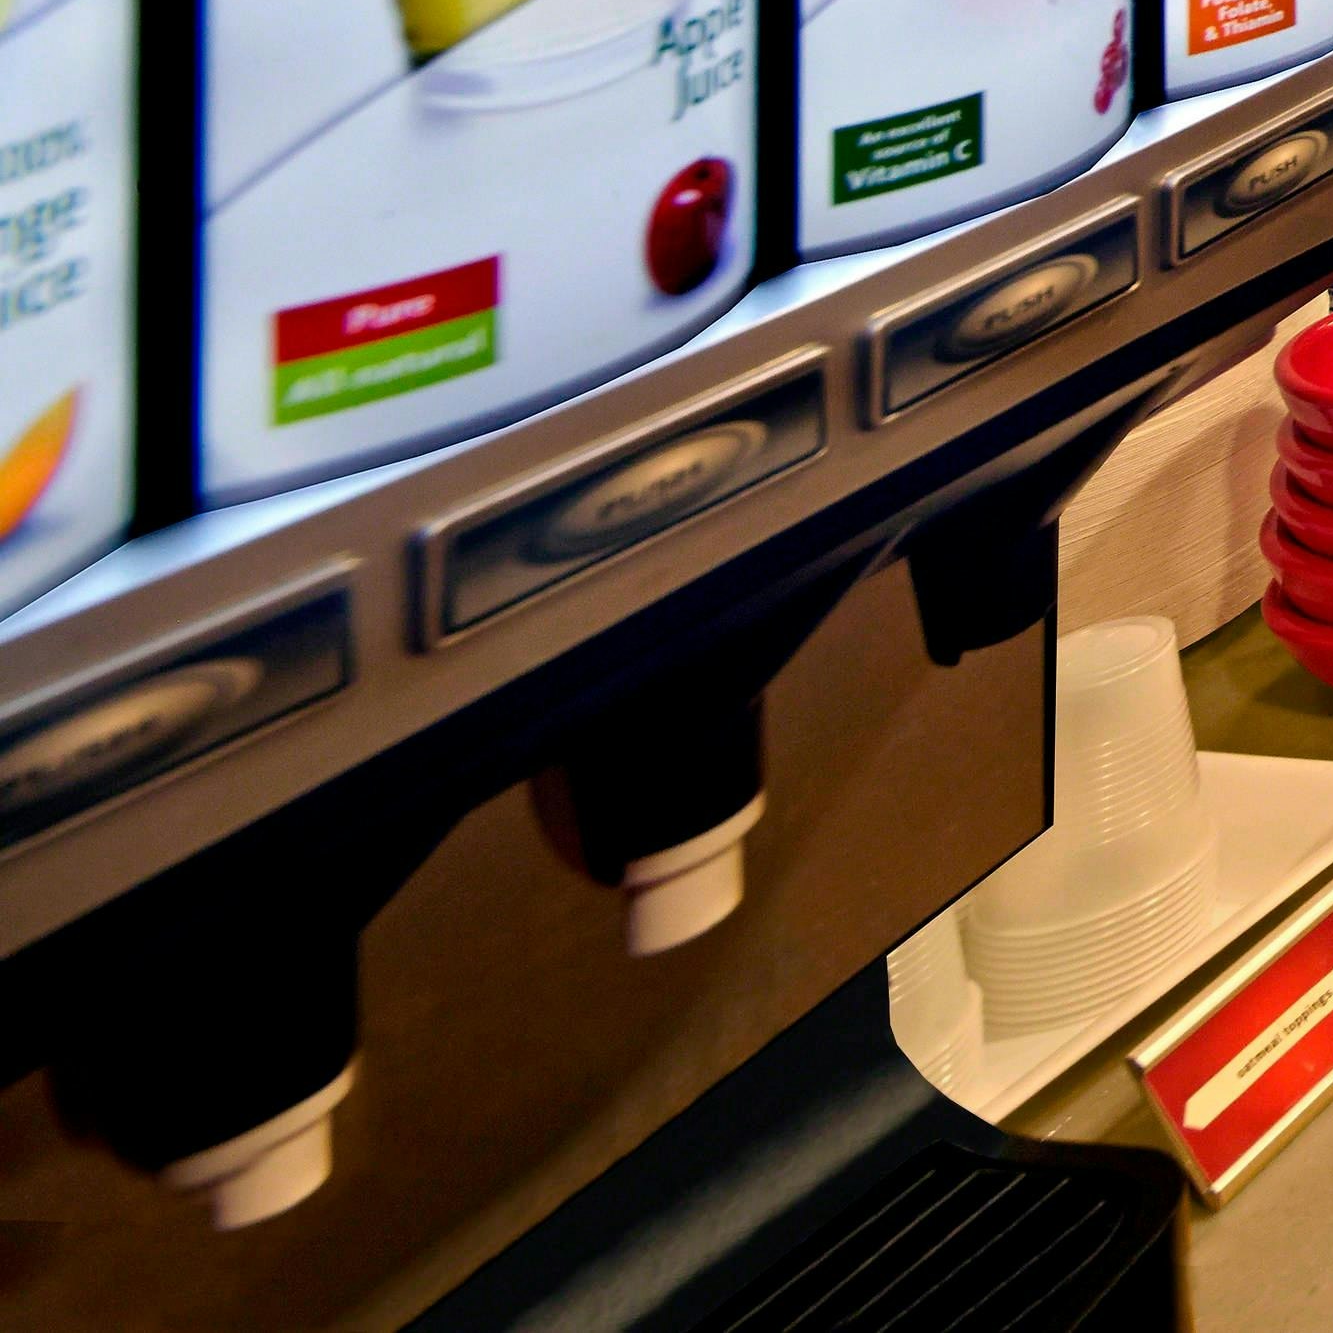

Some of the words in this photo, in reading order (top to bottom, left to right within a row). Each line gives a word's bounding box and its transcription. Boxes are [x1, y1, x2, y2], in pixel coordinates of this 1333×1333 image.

[952, 138, 974, 163] C
[1248, 155, 1299, 192] PUSH
[1283, 989, 1333, 1037] toppings
